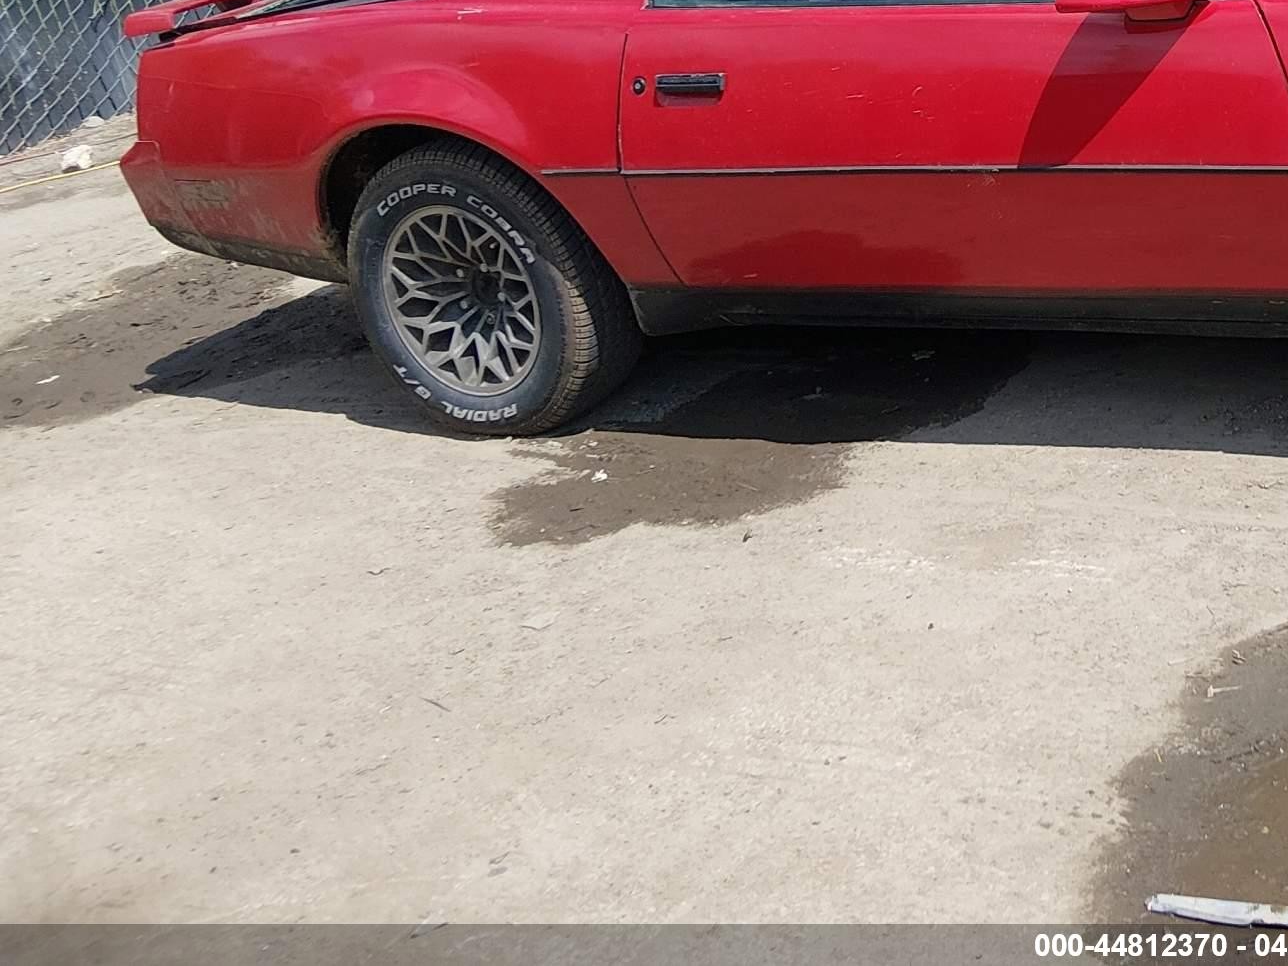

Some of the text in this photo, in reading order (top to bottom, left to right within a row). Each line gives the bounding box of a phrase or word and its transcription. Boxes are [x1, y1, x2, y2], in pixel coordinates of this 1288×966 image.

[376, 183, 536, 264] COOPER COBRA
[440, 400, 519, 422] RADIAL
